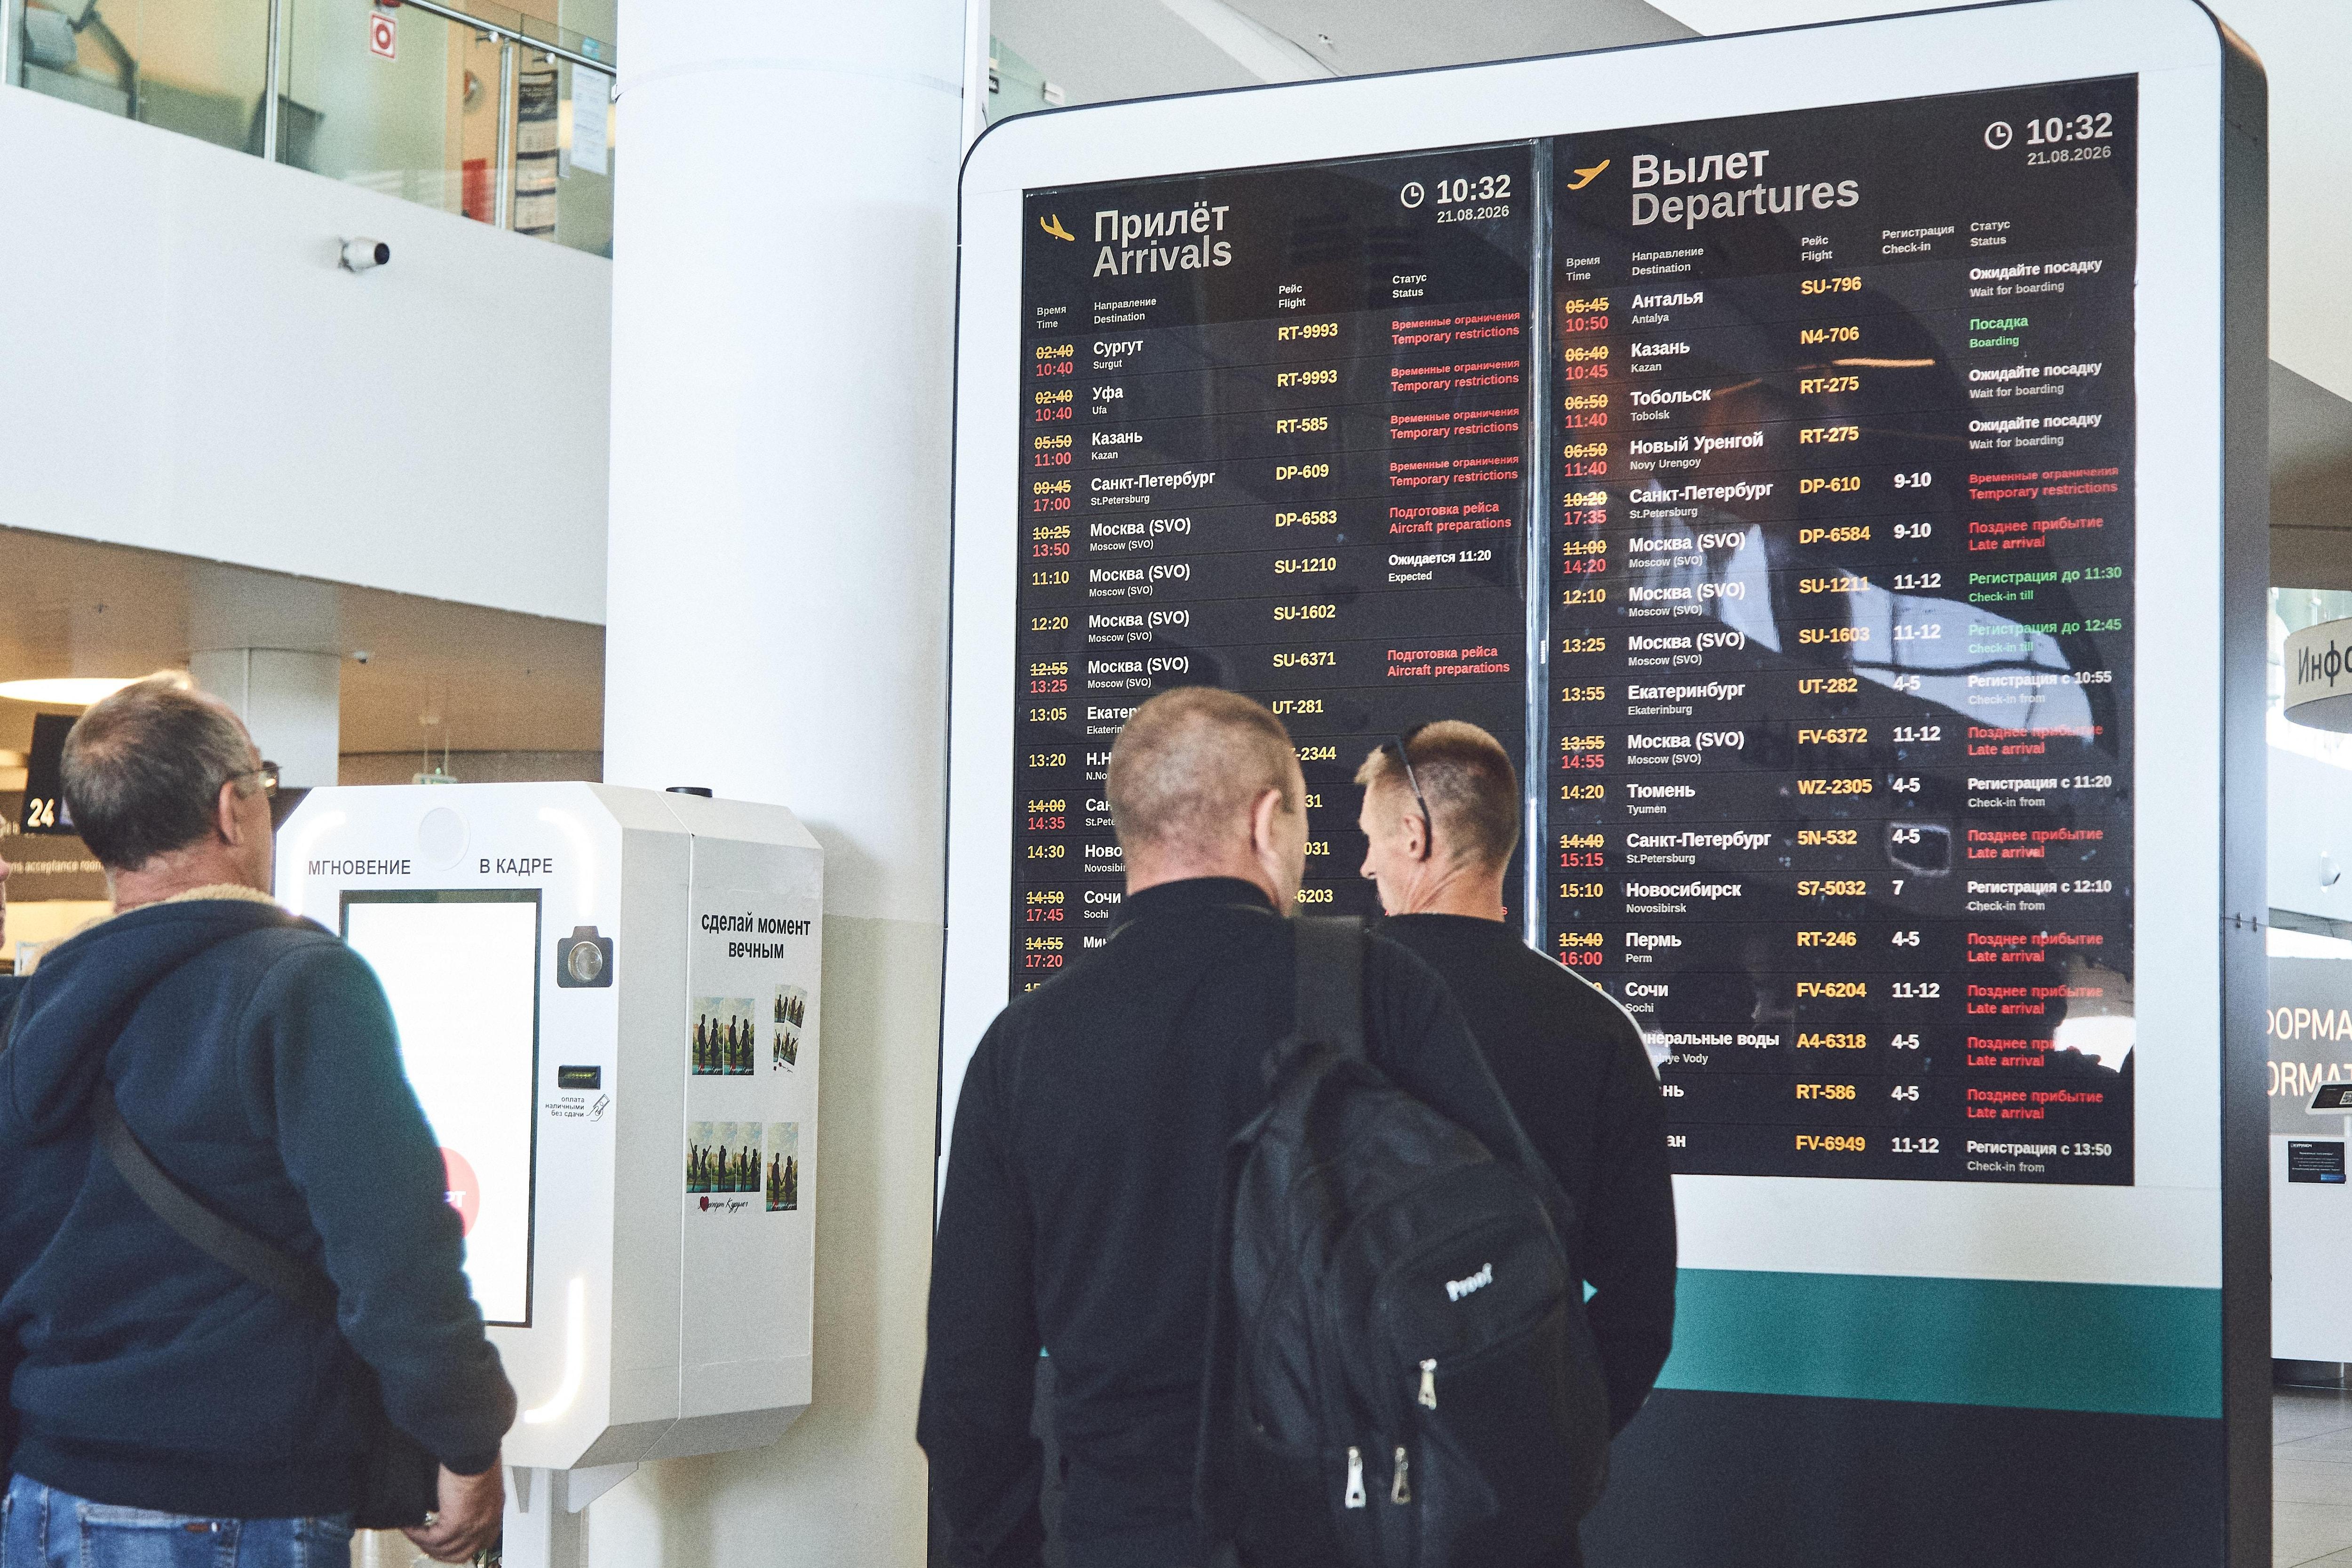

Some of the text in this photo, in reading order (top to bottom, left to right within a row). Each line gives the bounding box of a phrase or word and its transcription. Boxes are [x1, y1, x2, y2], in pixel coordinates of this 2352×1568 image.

[2026, 112, 2113, 145] 10:32
[2027, 145, 2111, 165] 21.08.2026
[1632, 150, 1769, 188] Вылет
[1437, 175, 1510, 204] 10:32
[1632, 180, 1859, 230] Departures
[1437, 205, 1510, 223] 21.08.2026
[1095, 201, 1229, 248] Прилёт
[1970, 221, 2010, 231] Статус
[1882, 226, 1954, 239] Регистрация
[1802, 236, 1828, 246] Рейс
[1882, 241, 1931, 254] Check-in
[1970, 237, 2006, 247] Status
[1093, 235, 1232, 277] Arrivals
[1566, 257, 1600, 268] Время
[1632, 248, 1704, 262] Направление
[1802, 250, 1833, 262] Flight
[1566, 271, 1591, 281] Time
[1632, 263, 1691, 276] Destination
[1969, 260, 2102, 281] Ожидайте посадку
[1392, 275, 1427, 284] Статус
[1801, 276, 1862, 294] SU-796
[1279, 284, 1302, 294] Рейс
[1392, 289, 1423, 298] Status
[1970, 281, 2064, 297] Wait for boarding
[1094, 299, 1156, 311] Направление
[1279, 297, 1306, 309] Flight
[1565, 297, 1609, 314] 05:45
[1631, 292, 1703, 309] Анталья
[1037, 306, 1066, 317] Время
[1094, 312, 1145, 324] Destination
[1631, 313, 1669, 324] Antalya
[1036, 319, 1058, 329] Time
[1392, 312, 1520, 331] Временные ограничения
[1566, 316, 1608, 332] 10:50
[1970, 318, 2028, 331] Посадка
[1278, 323, 1338, 341] RT-9993
[1391, 326, 1519, 346] Temporary restrictions
[1801, 326, 1859, 344] N4-706
[1094, 341, 1144, 358] Сургут
[1631, 342, 1690, 357] Казань
[1970, 336, 2019, 348] Boarding
[1036, 344, 1074, 359] 02:40
[1036, 361, 1073, 376] 10:40
[1093, 359, 1122, 370] Surgut
[1278, 370, 1337, 387] RT-9993
[1800, 376, 1859, 394] RT-275
[1035, 390, 1073, 404] 02:40
[1093, 386, 1123, 403] Уфа
[1629, 389, 1713, 406] Тобольск
[1092, 406, 1107, 414] Ufa
[1630, 410, 1669, 421] Tobolsk
[1277, 417, 1327, 434] RT-585
[1034, 435, 1072, 449] 05:50
[1092, 432, 1143, 446] Казань
[1630, 431, 1763, 455] Новый Уренгой
[1092, 452, 1118, 460] Kazan
[1276, 464, 1329, 480] DP-609
[1630, 459, 1701, 471] Novy Urengoy
[1091, 470, 1216, 491] Санкт-Петербург
[1800, 477, 1860, 493] DP-610
[1894, 472, 1931, 488] 9-10
[1629, 479, 1773, 503] Санкт-Петербург
[1091, 494, 1150, 505] St.Petersburg
[1390, 501, 1499, 519] Подготовка рейса
[1276, 510, 1337, 527] DP-6583
[1390, 517, 1511, 534] Aircraft preparations
[1969, 517, 2103, 535] Позднее прибытие
[1033, 525, 1071, 540] 10:25
[1799, 526, 1871, 544] DP-6584
[1969, 535, 2045, 551] Late arrival
[1274, 557, 1336, 573] SU-1210
[1388, 549, 1491, 567] Ожидается 11:20
[1033, 571, 1069, 585] 11:10
[1090, 564, 1190, 586] Москва (SVO)
[1389, 571, 1432, 583] Expected
[1894, 573, 1941, 589] 11-12
[1969, 566, 2122, 585] Регистрация до 11:30
[1089, 584, 1152, 597] Moscow (SVO)
[1969, 590, 2033, 602] Check-in till
[1274, 605, 1335, 621] SU-1602
[1273, 652, 1336, 667] SU-6371
[1031, 679, 1067, 693] 13:25
[1628, 681, 1746, 702] Екатеринбург
[1798, 678, 1858, 694] UT-282
[1030, 708, 1067, 721] 13:05
[1273, 700, 1324, 714] UT-281
[1628, 704, 1692, 716] Ekaterinburg
[1798, 728, 1867, 744] FV-6372
[1626, 784, 1695, 798] Тюмень
[1797, 779, 1872, 795] WZ-2305
[28, 798, 55, 828] 24
[1028, 799, 1066, 812] 14:00
[1627, 803, 1667, 816] Tyumen
[1797, 830, 1857, 845] 5N-532
[309, 858, 553, 876] МГНОВЕНИЕ В КАДРЕ
[1560, 883, 1603, 898] 15:10
[1626, 881, 1741, 900] Новосибирск
[1797, 881, 1866, 896] S7-5032
[1892, 880, 1904, 895] 7
[1026, 891, 1065, 904] 14:50
[1084, 891, 1120, 904] Сочи
[1027, 908, 1064, 921] 17:45
[1084, 907, 1108, 918] Sochi
[1626, 903, 1686, 913] Novosibirsk
[701, 911, 810, 936] сделай момент
[1558, 933, 1604, 947] 15:40
[1626, 932, 1682, 951] Пермь
[1797, 931, 1857, 947] RT-246
[729, 942, 784, 959] вечным
[1626, 954, 1652, 963] Perm
[1625, 982, 1668, 996] Сочи
[1796, 983, 1867, 997] FV-6204
[1736, 1030, 1780, 1049] воды
[1796, 1034, 1867, 1049] A4-6318
[1891, 1034, 1920, 1050] 4-5
[1683, 1053, 1708, 1065] Vody
[1796, 1084, 1856, 1100] RT-586
[1796, 1135, 1865, 1151] FV-6949
[1967, 1140, 2112, 1157] Регистрация с 13:50
